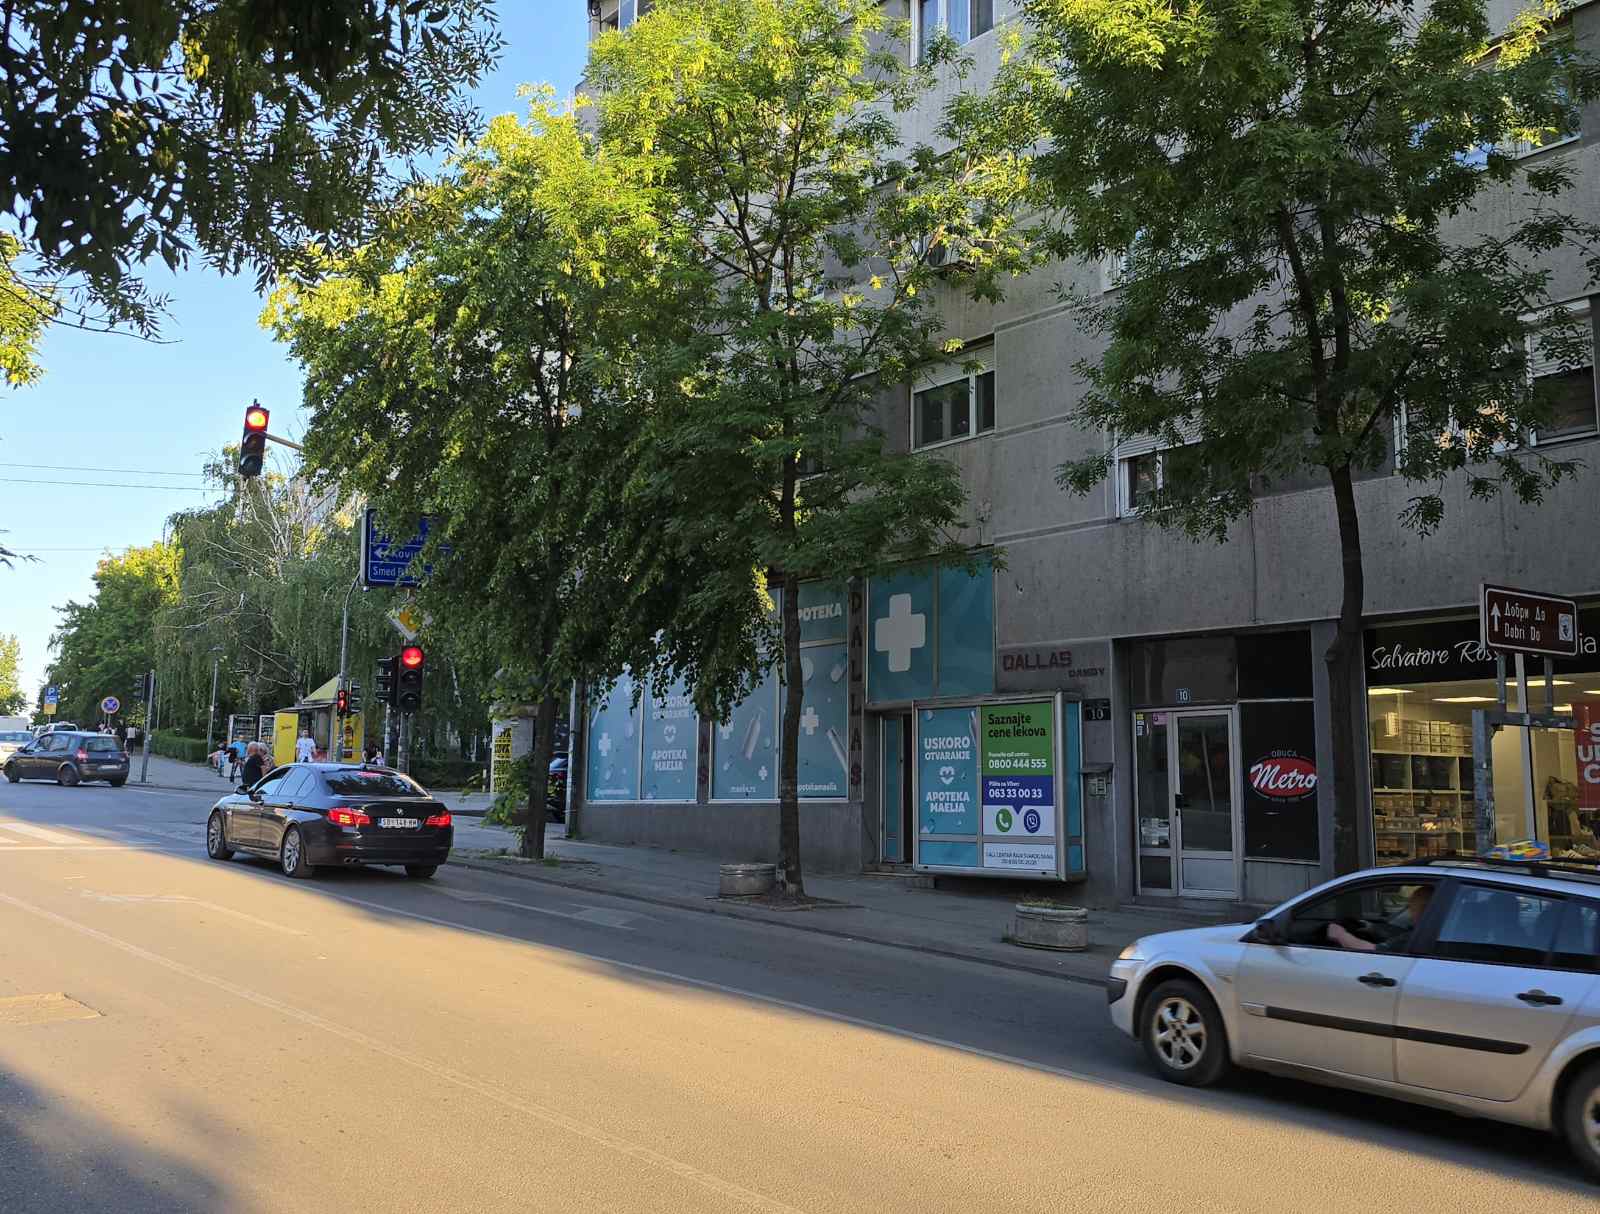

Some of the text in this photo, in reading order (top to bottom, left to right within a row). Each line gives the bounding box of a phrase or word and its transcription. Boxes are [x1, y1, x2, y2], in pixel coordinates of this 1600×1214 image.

[798, 602, 842, 621] POTEKA
[1504, 601, 1546, 622] Добри До
[1504, 623, 1541, 642] Dobri Do
[1003, 650, 1072, 671] DALLAS
[1370, 644, 1449, 670] Salvatore
[1179, 690, 1188, 701] 10
[988, 712, 1032, 726] Saznajte
[1091, 708, 1104, 720] 10
[988, 725, 1047, 739] cene lekova
[924, 735, 971, 750] USKORO
[924, 750, 971, 760] OTVARANJE
[988, 758, 1047, 769] 0800 444 555
[1250, 763, 1317, 790] Metro
[926, 791, 970, 802] APOTEKA
[988, 788, 1043, 798] 063 33 00 33
[930, 802, 966, 813] MAELIA
